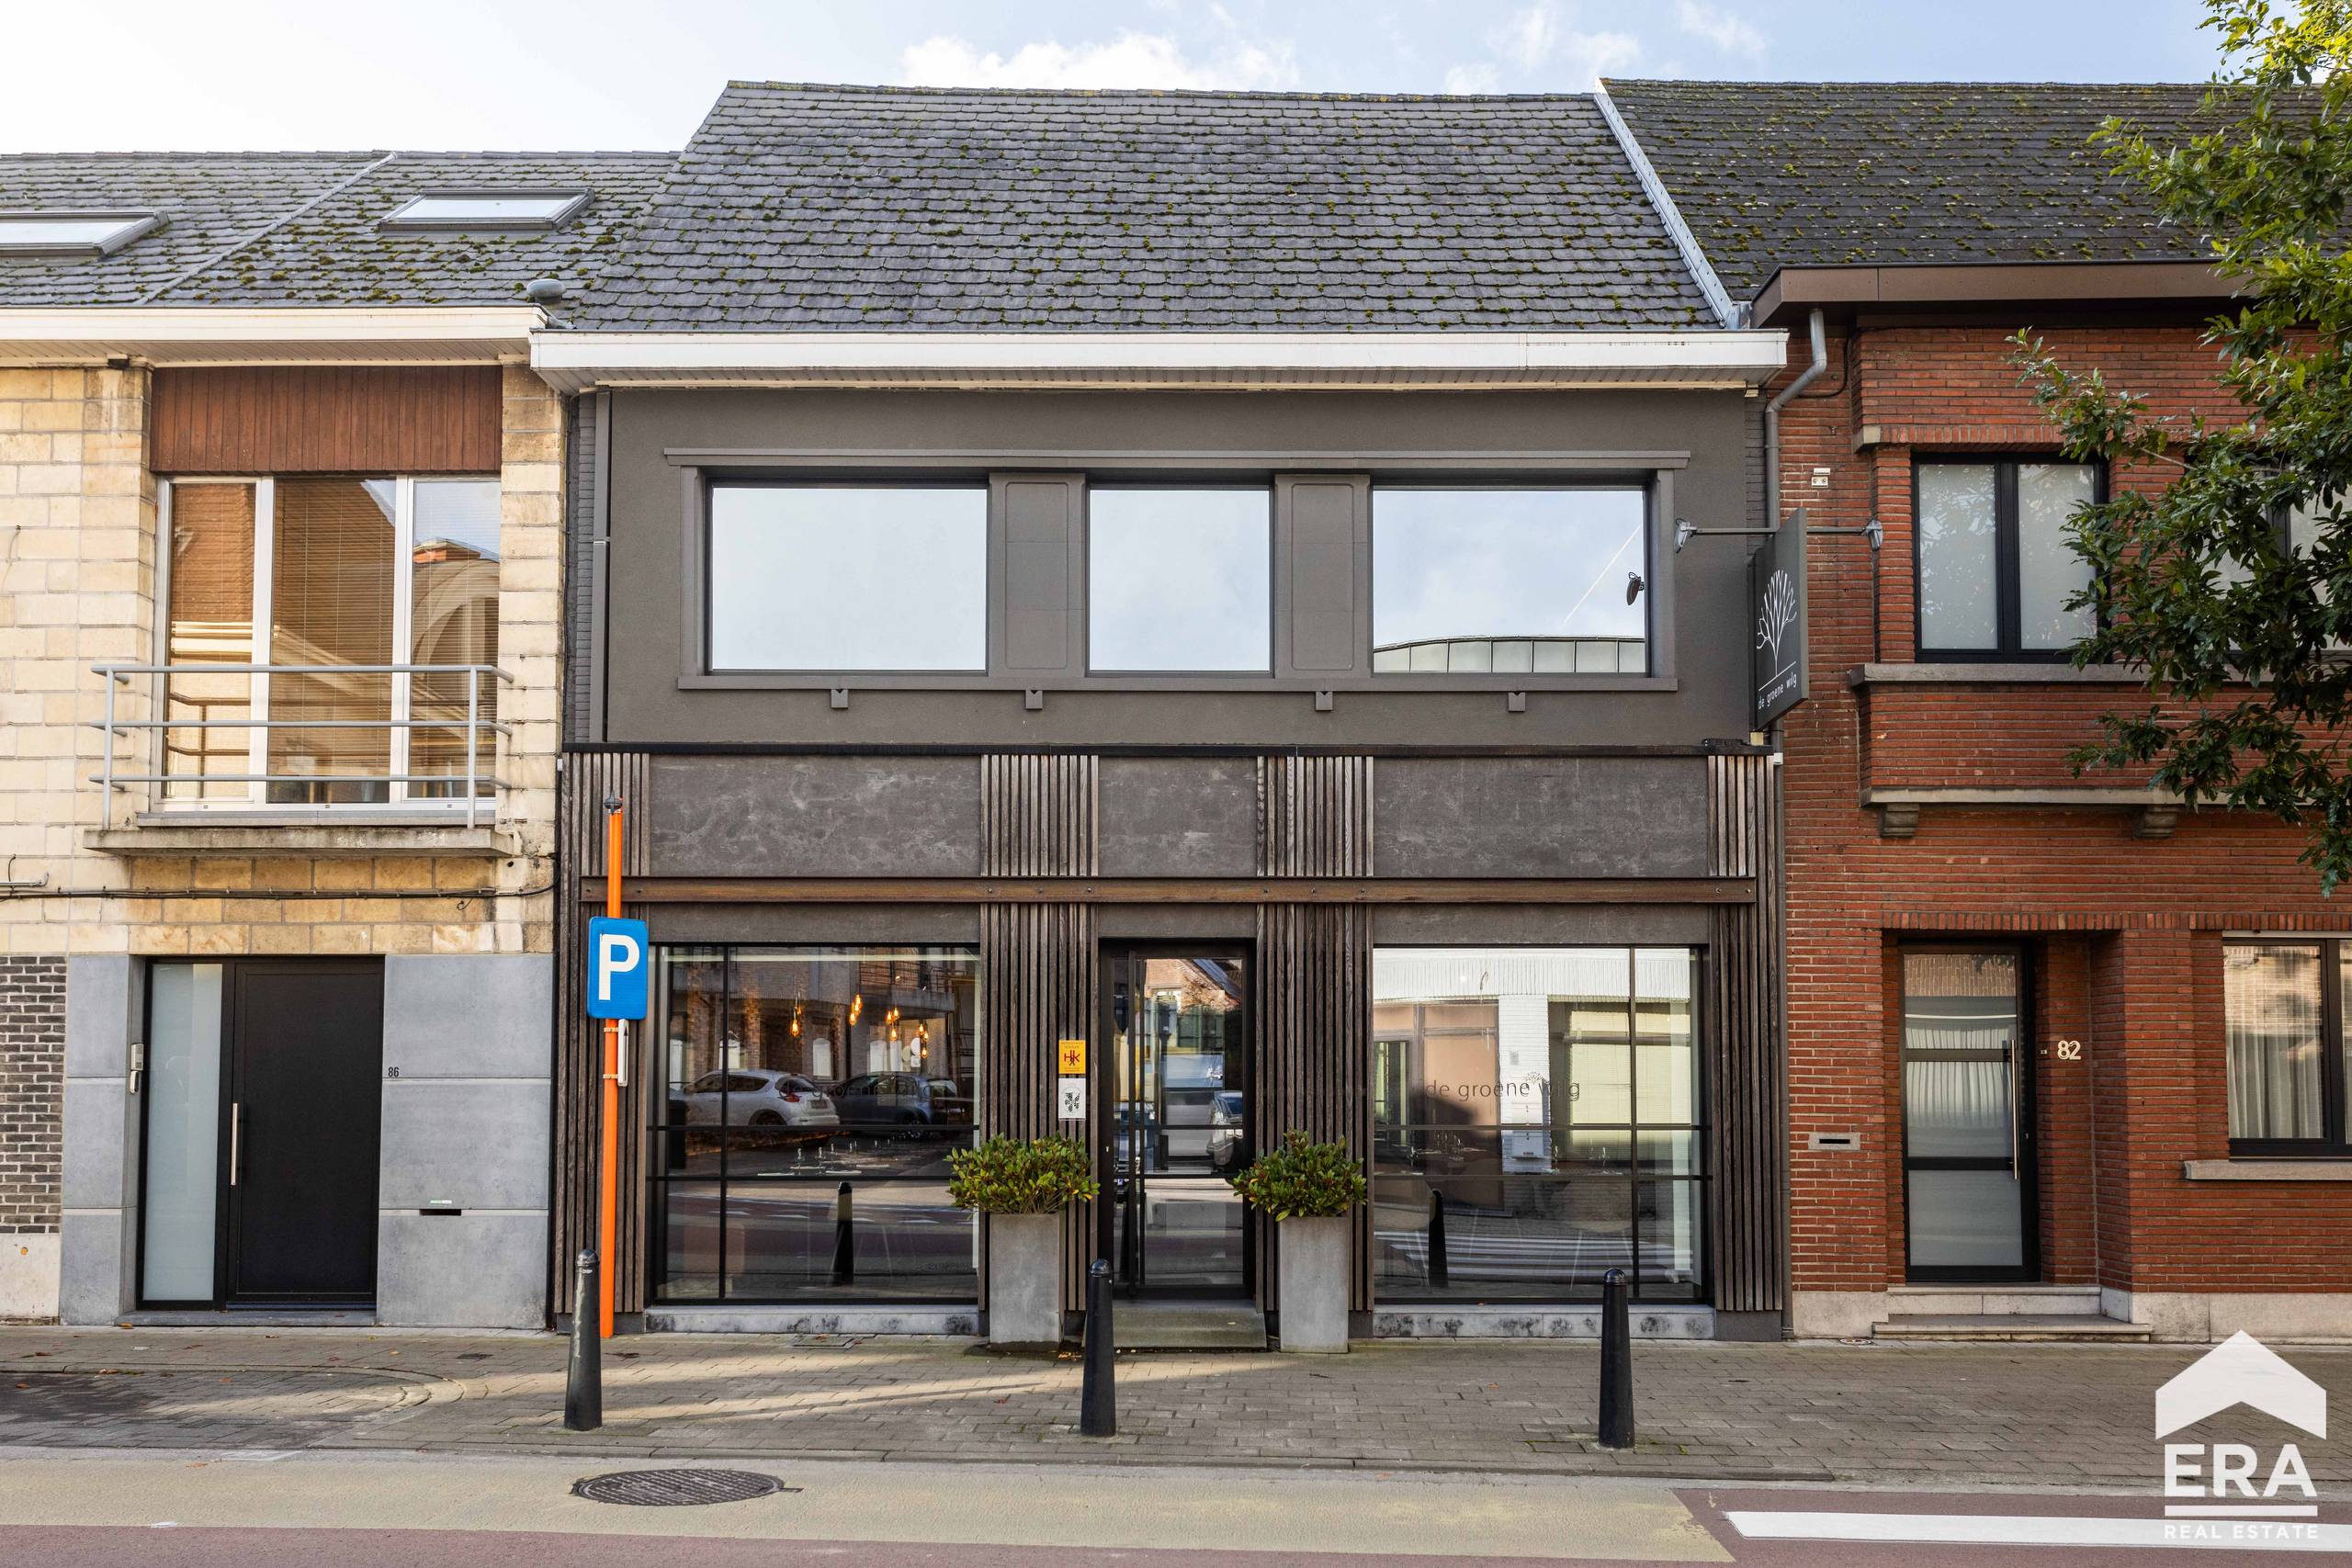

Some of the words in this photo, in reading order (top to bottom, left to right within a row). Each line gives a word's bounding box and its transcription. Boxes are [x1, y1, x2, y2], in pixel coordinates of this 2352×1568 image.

[1758, 694, 1765, 709] de
[1767, 683, 1784, 707] groene
[1786, 671, 1797, 689] wilg
[598, 933, 640, 1000] P
[2057, 1040, 2082, 1060] 82
[388, 1066, 400, 1077] 86
[1425, 1079, 1450, 1098] de
[1458, 1081, 1530, 1102] groene
